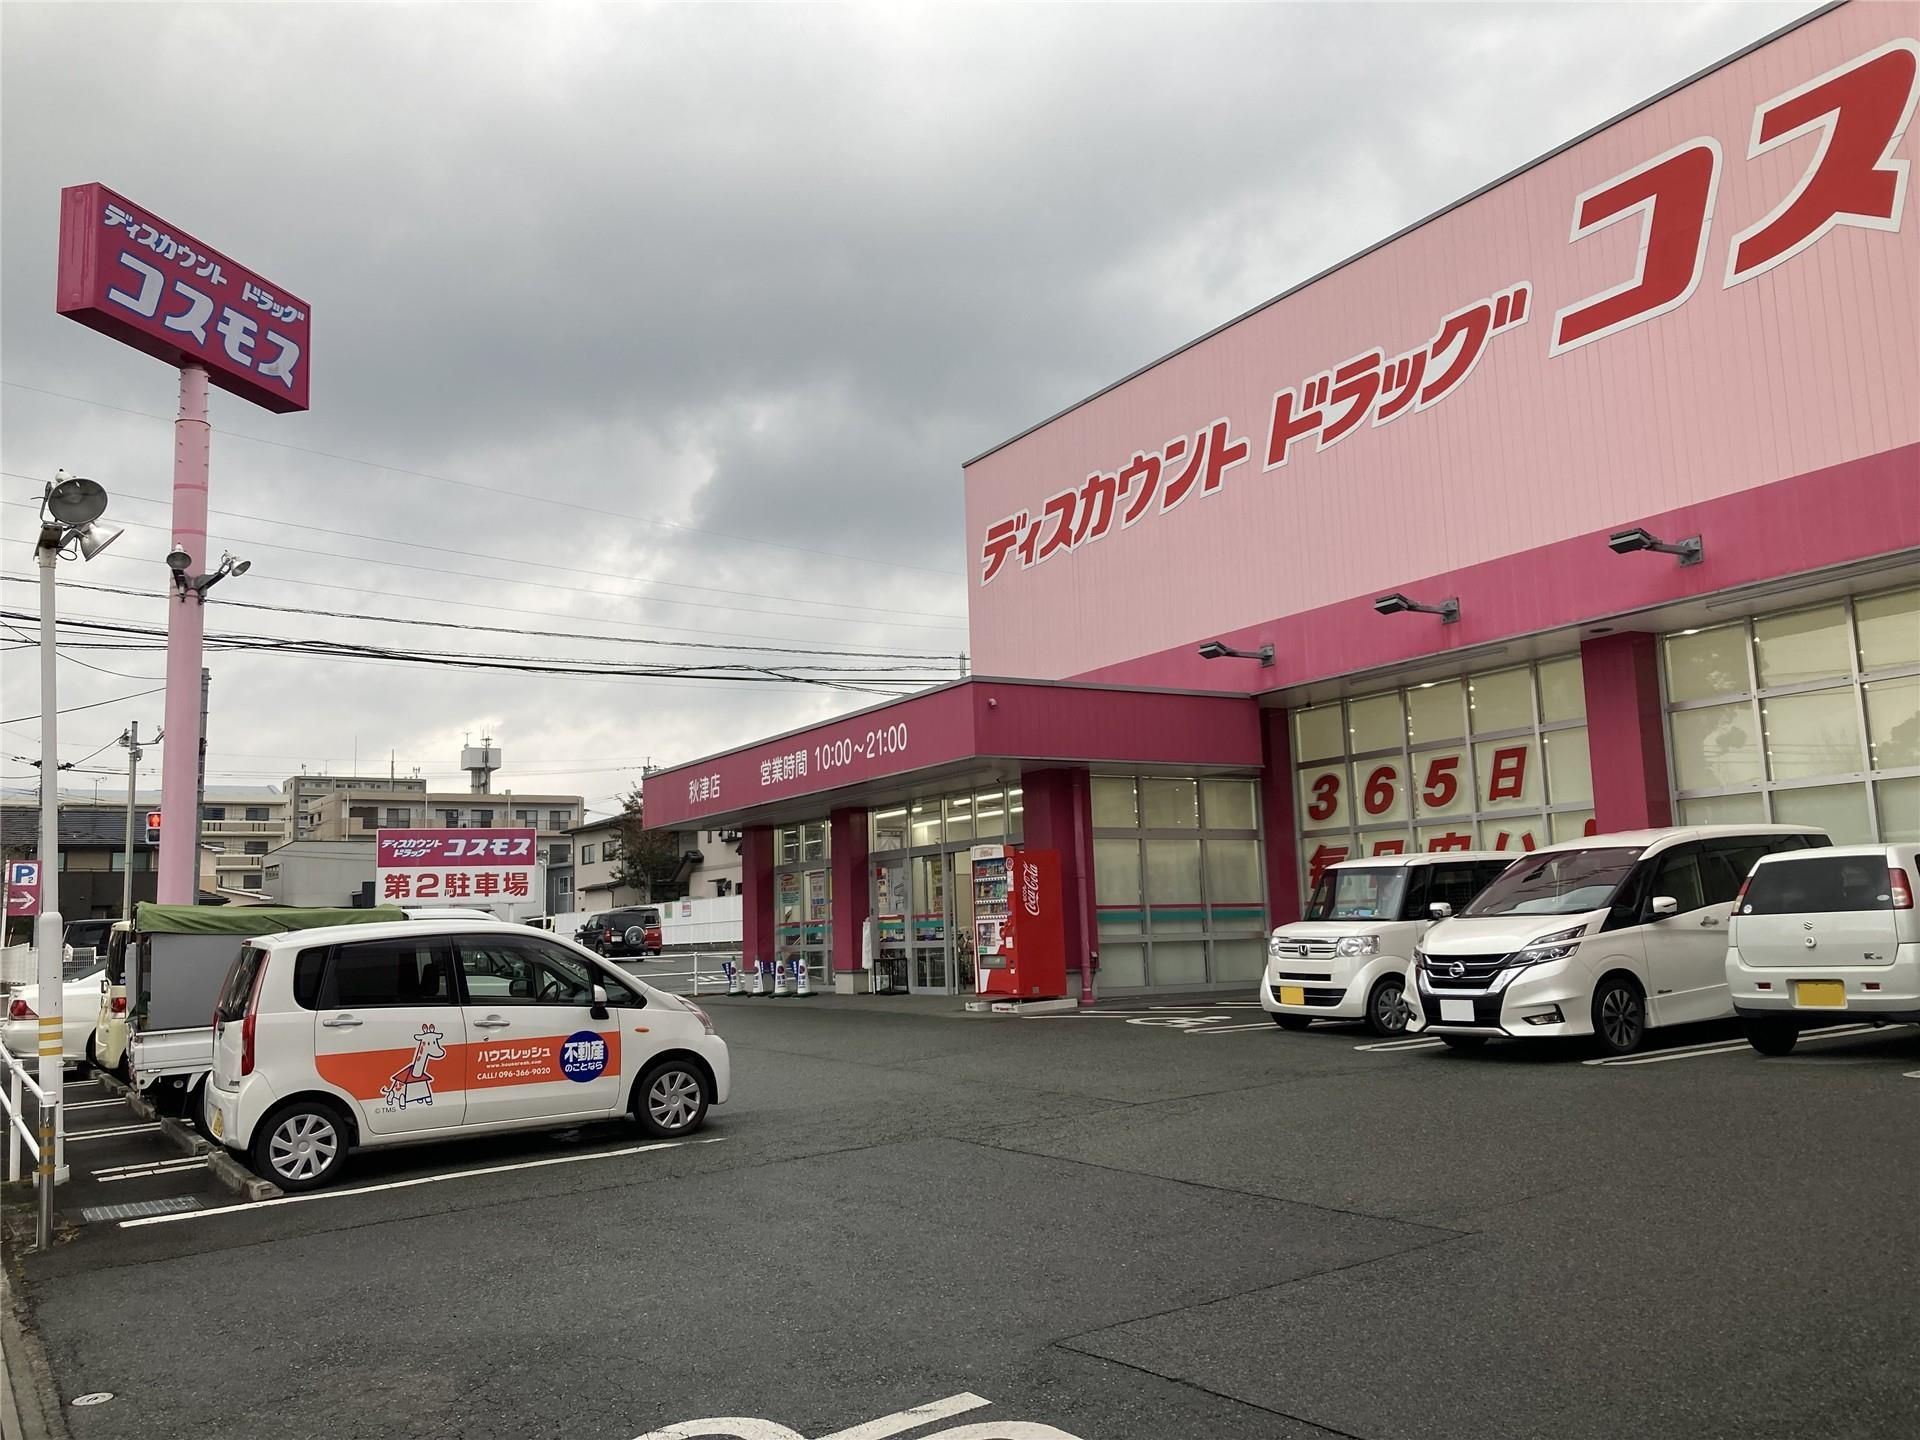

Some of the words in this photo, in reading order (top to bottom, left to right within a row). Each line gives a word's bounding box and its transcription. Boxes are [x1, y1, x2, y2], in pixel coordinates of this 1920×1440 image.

[104, 203, 227, 286] ディスカウント
[241, 282, 305, 323] ドラッグ
[107, 251, 301, 389] コスモス
[982, 420, 1249, 584] ディスカウント
[1265, 284, 1531, 470] ドラッグ
[1553, 43, 1919, 351] コス
[688, 772, 721, 804] 秋津店
[760, 750, 808, 786] 営業時間
[1308, 746, 1528, 821] 365日
[381, 838, 443, 849] ディスカウント
[443, 838, 531, 857] コスモス
[384, 871, 529, 899] 第2駐車場
[477, 1046, 551, 1063] ハウスレッシュ
[564, 1040, 605, 1062] 不動産
[498, 1067, 551, 1079] 096-366-9020
[564, 1061, 603, 1073] のことなら
